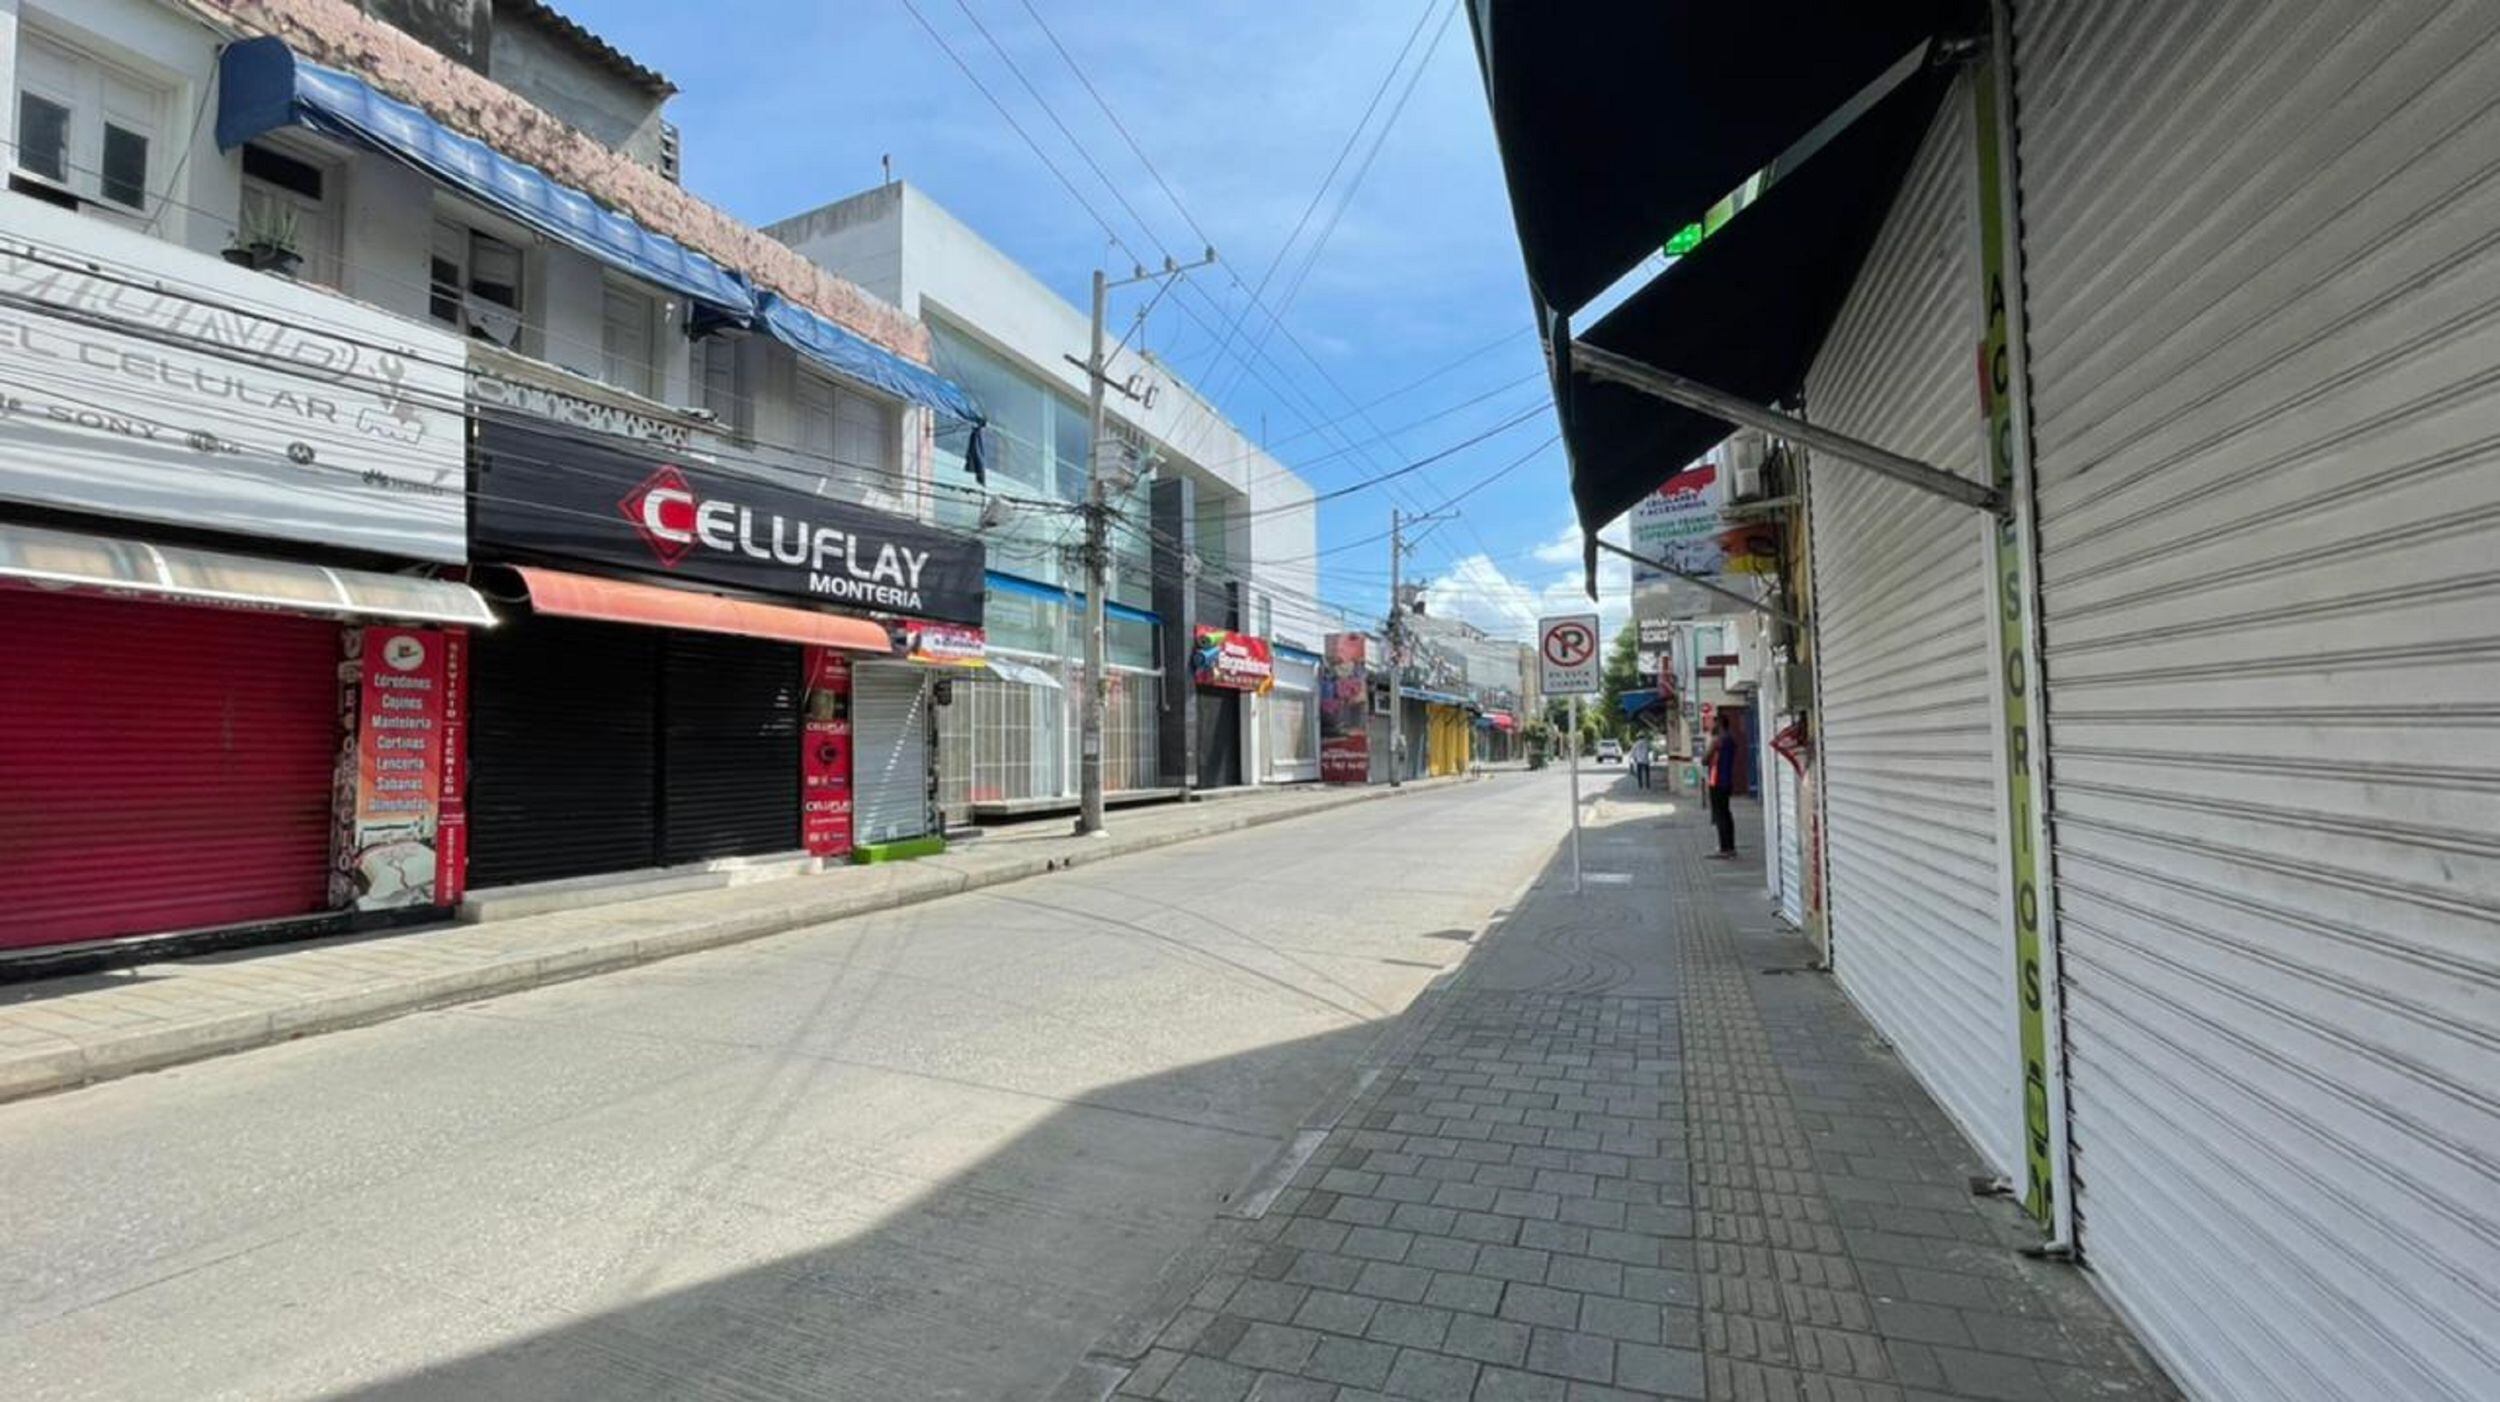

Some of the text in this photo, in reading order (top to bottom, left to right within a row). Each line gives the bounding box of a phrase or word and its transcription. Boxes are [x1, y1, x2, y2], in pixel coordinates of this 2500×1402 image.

[79, 342, 338, 424] CELULAR
[46, 405, 161, 439] SONY
[643, 487, 929, 588] CELUFLAY
[809, 571, 923, 610] MONTERIA
